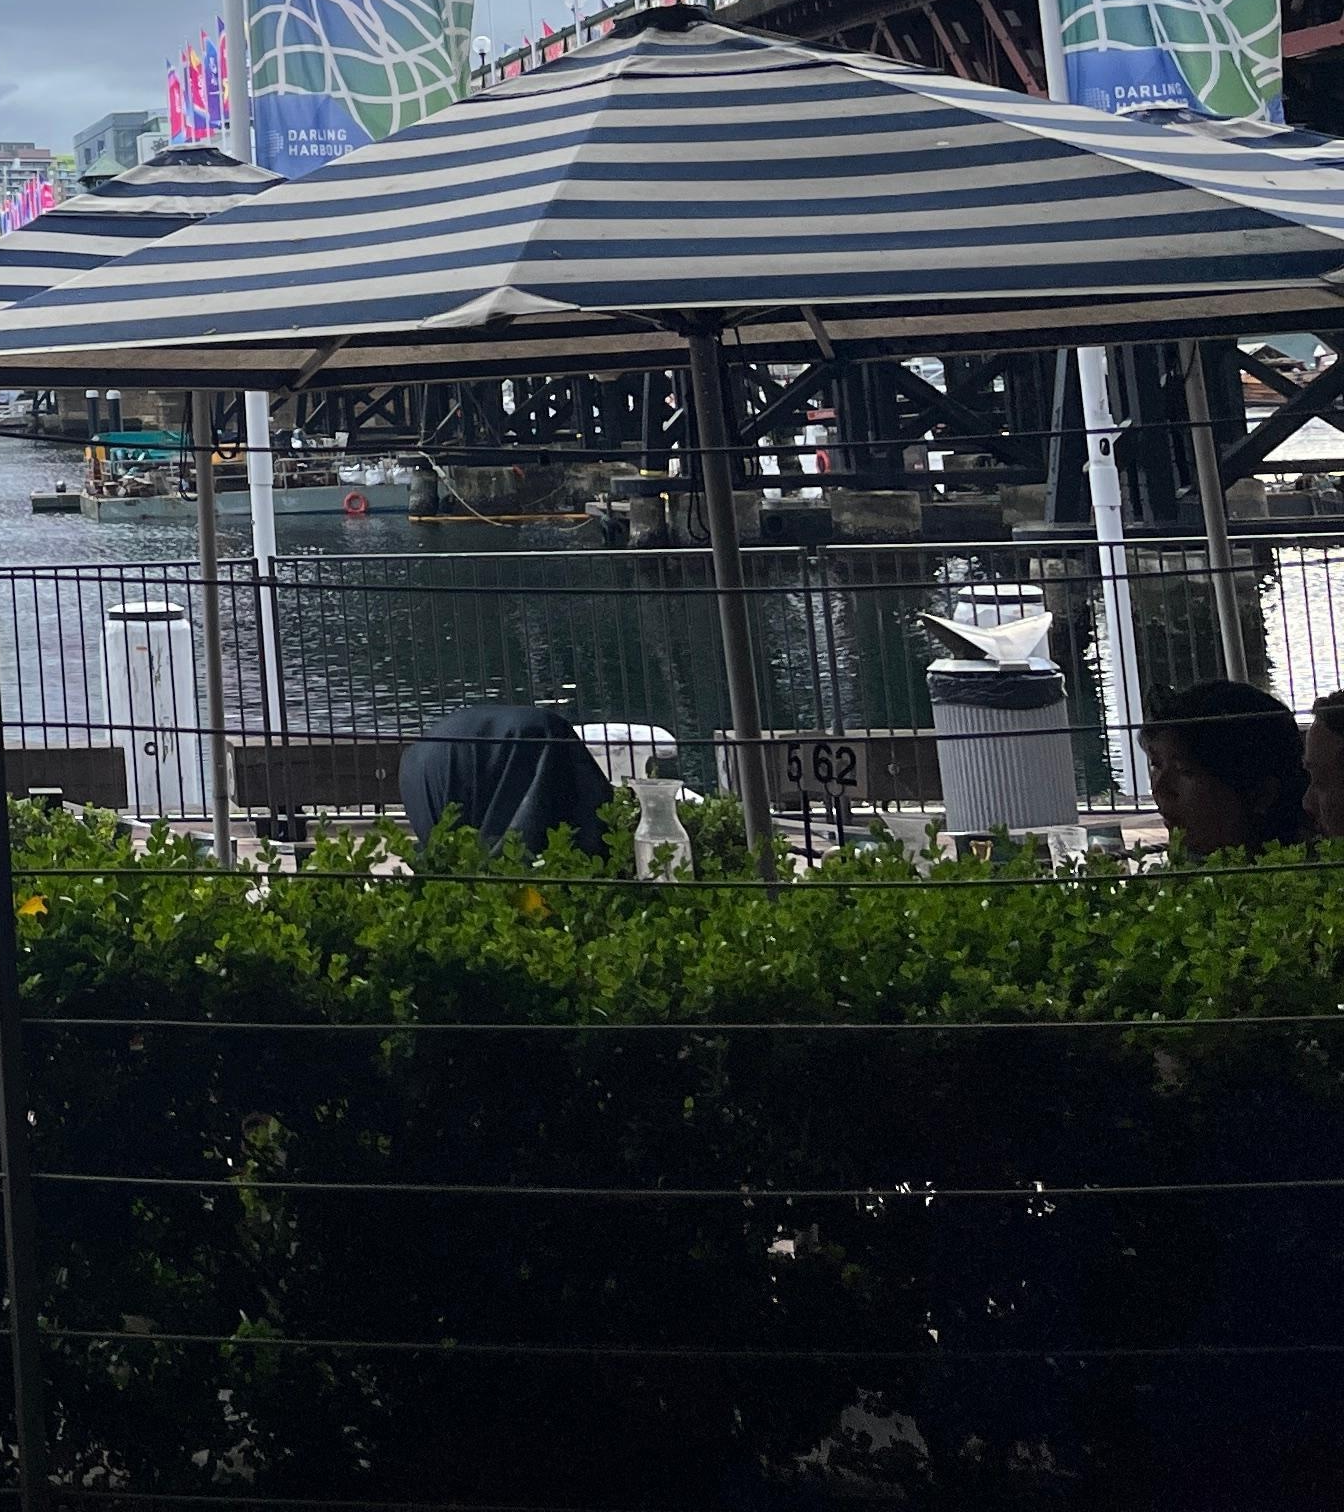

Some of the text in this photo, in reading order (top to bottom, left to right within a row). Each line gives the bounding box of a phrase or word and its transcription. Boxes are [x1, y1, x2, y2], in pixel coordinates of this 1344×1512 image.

[1114, 82, 1183, 99] DARLING
[287, 128, 347, 142] DARLING
[288, 144, 354, 157] HARBOUR
[813, 742, 858, 787] 62
